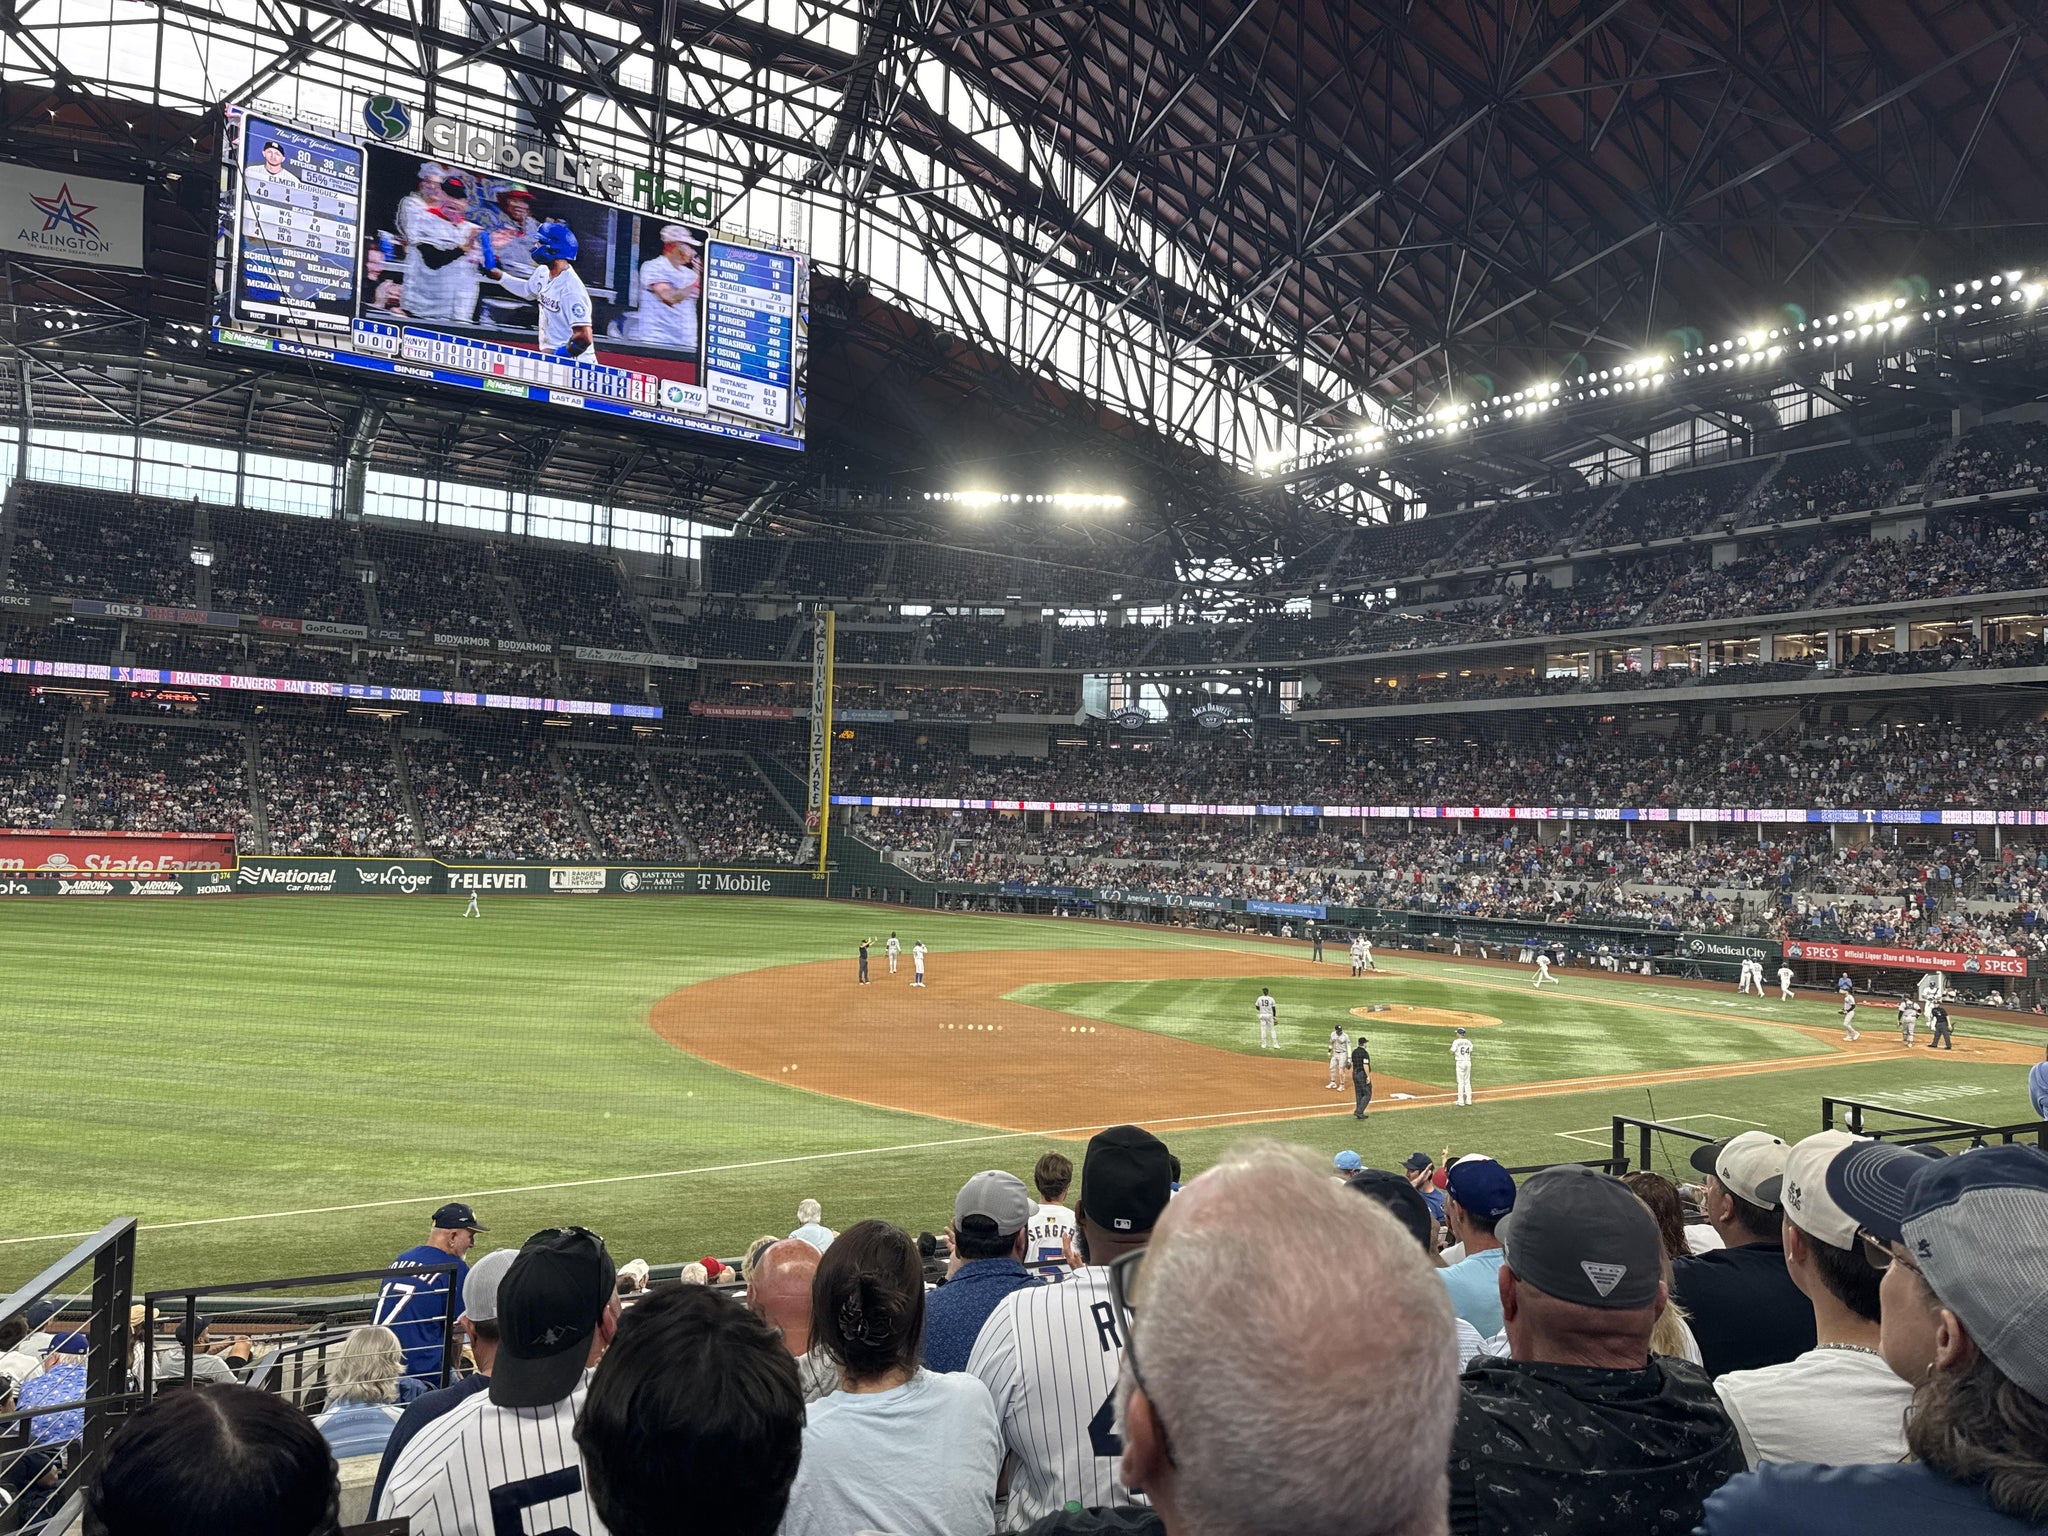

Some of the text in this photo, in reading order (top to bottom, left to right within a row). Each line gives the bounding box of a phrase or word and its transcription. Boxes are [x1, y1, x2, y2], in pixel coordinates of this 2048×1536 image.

[297, 150, 355, 176] 80 38 42
[424, 116, 712, 220] Globe Life Field
[269, 175, 296, 189] ELMER
[306, 172, 328, 186] 55%
[256, 188, 269, 197] 4.0
[285, 195, 290, 203] 4
[313, 202, 318, 210] 3
[278, 217, 350, 239] 0-0 4.0 0.00
[18, 228, 110, 252] ARLINGTON
[277, 234, 350, 255] 15.0 20.0 2.00
[283, 249, 318, 262] GRISHAM
[307, 263, 350, 278] BELLINGER
[720, 259, 745, 271] NIMMO
[246, 264, 352, 290] CABALLERO CHISHOLM JR.
[720, 270, 738, 281] JUNG
[720, 282, 747, 294] SEAGER
[319, 292, 336, 301] RICE
[250, 312, 266, 320] RICE
[719, 303, 756, 319] PEDERSON
[718, 314, 747, 328] BURGER
[386, 327, 392, 335] O
[718, 325, 746, 339] CARTER
[233, 333, 268, 346] National
[358, 334, 392, 350] 0 0 0
[278, 343, 305, 355] 94.4
[306, 347, 335, 360] MPH
[413, 350, 427, 359] TEX
[717, 347, 741, 360] OSUNA
[413, 336, 640, 389] NYY 2
[717, 358, 741, 371] DURAN
[393, 365, 434, 379] SINKER
[495, 381, 525, 393] National
[720, 377, 776, 398] DISTANCE 61.0
[551, 395, 571, 404] LAST
[684, 391, 702, 401] TXU
[712, 385, 726, 394] EXIT
[763, 398, 777, 407] 93.5
[716, 395, 774, 416] EXIT ANGLE 1.2
[629, 409, 760, 440] JOSH JUNG SINGLED TO LEFT
[105, 603, 207, 624] 105.3 THE FAN
[272, 620, 298, 631] PGL
[305, 624, 364, 637] GoPGL.com
[379, 631, 404, 640] PGL
[434, 634, 490, 647] BODYARMOR
[498, 640, 552, 653] BODYARMOR
[578, 648, 604, 660] Blue
[176, 673, 222, 687] RANGERS
[230, 677, 277, 691] RANGERS
[284, 680, 329, 695] RANERS
[391, 688, 421, 702] SCORE!
[1192, 706, 1206, 717] JACK
[811, 752, 821, 805] FARE
[1446, 808, 1510, 818] RANGERS RANGERS
[1594, 809, 1620, 820] SCORE!
[260, 868, 336, 884] National
[380, 866, 433, 893] Kroger
[553, 871, 566, 885] T
[715, 874, 771, 892] Mobile
[72, 881, 105, 890] ARROW
[144, 881, 175, 890] ARROW
[197, 885, 231, 895] HONDA
[1127, 894, 1151, 903] American
[1189, 900, 1215, 909] American
[1706, 944, 1767, 959] Medical City
[1806, 946, 1839, 958] SPEC'S
[1844, 950, 1864, 960] Official
[1864, 952, 1882, 963] Liquor
[1883, 953, 1898, 962] Store
[1905, 955, 1915, 963] the
[1916, 956, 1932, 965] Texas
[1932, 957, 1956, 967] Rangers
[1984, 960, 2024, 973] SPEC'S
[1460, 1047, 1469, 1055] 64
[1028, 1225, 1076, 1242] SEAGER
[373, 1282, 416, 1326] 17
